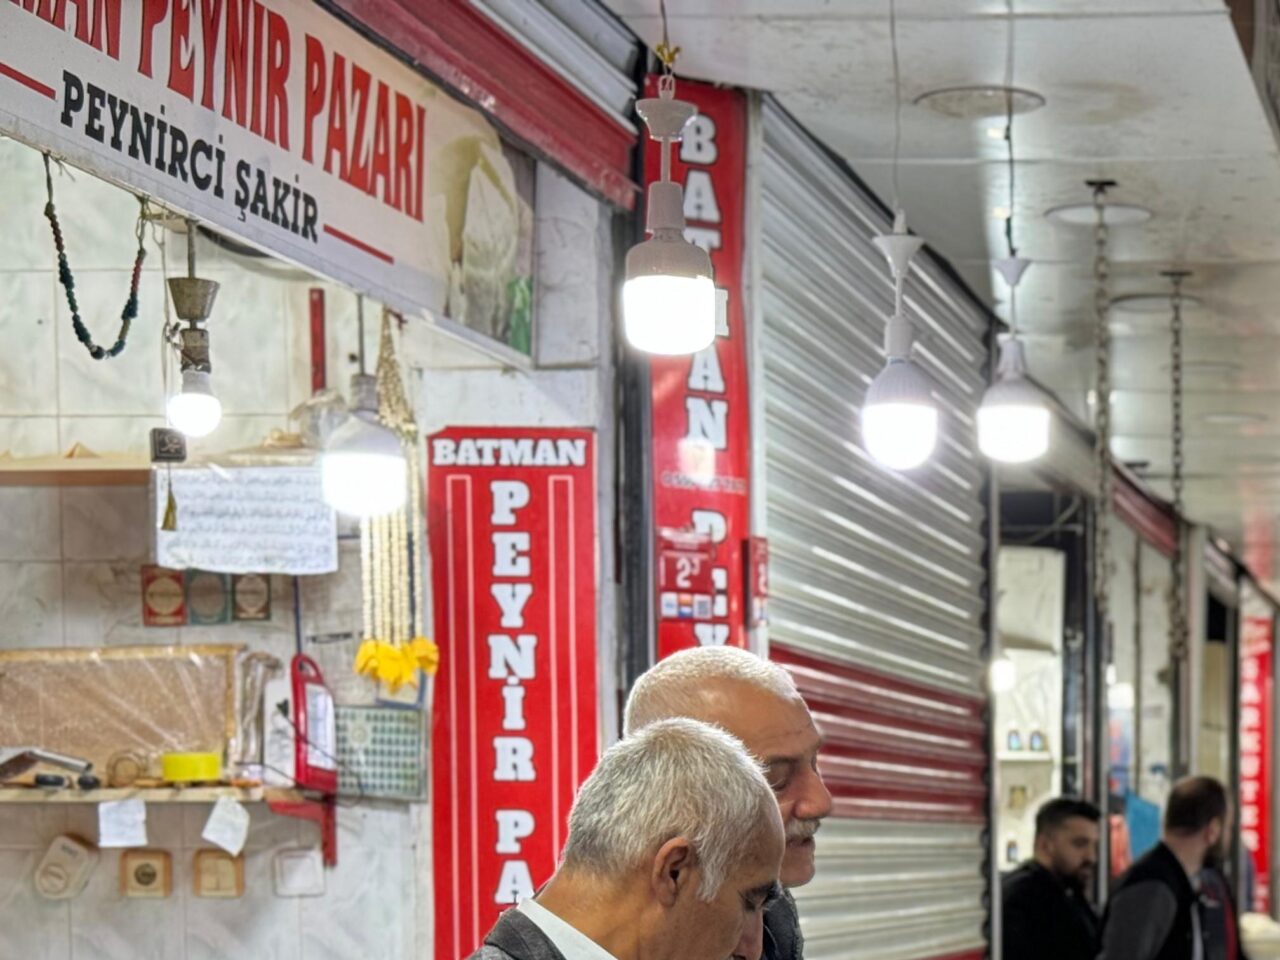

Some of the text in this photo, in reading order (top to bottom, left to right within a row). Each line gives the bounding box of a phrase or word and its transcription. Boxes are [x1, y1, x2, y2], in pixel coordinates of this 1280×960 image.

[60, 69, 318, 243] PEYNİRCİ ŞAKİR
[302, 32, 426, 224] PAZARI
[432, 438, 587, 467] BATMAN
[494, 808, 541, 908] PA
